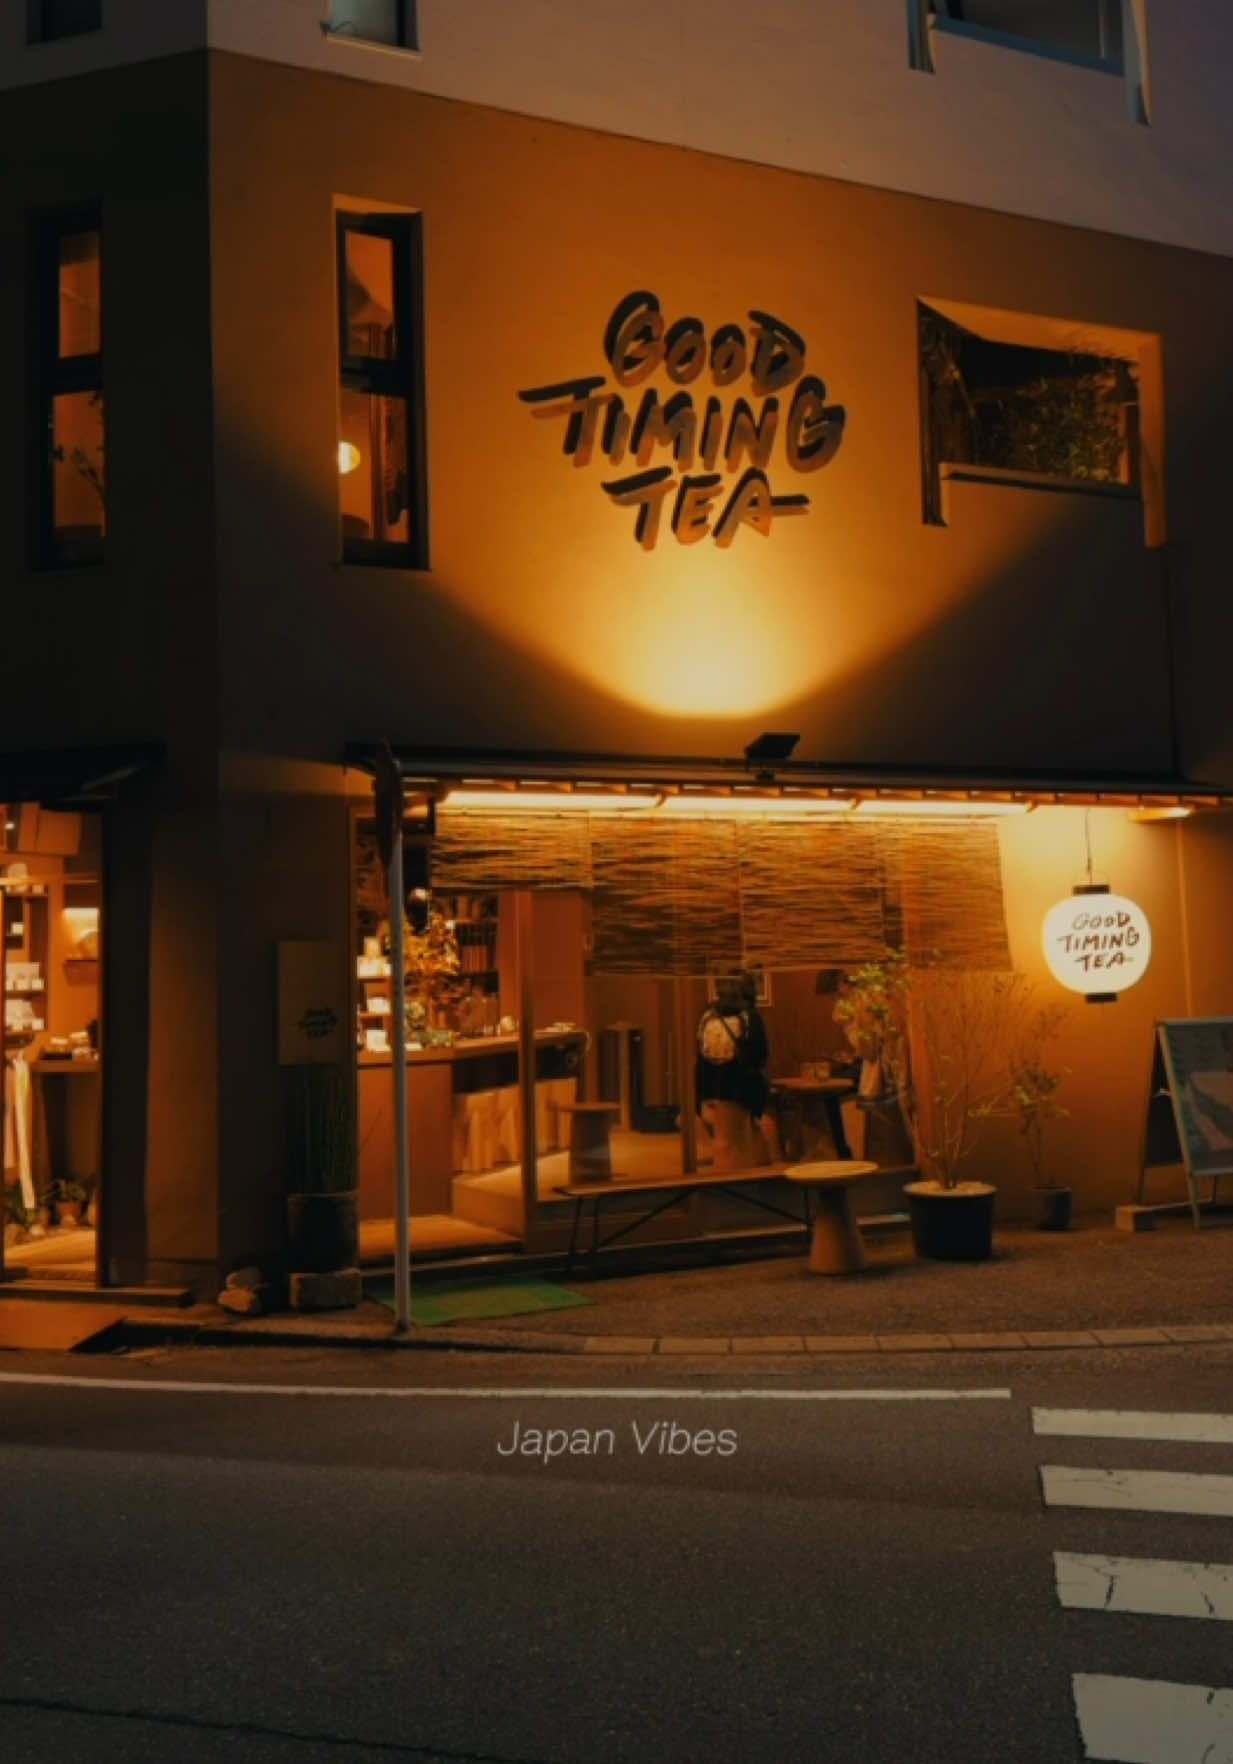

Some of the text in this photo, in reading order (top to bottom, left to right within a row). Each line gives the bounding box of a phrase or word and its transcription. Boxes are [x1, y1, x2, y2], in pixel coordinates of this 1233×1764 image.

[604, 291, 806, 395] GOOD
[518, 376, 846, 473] TIMING
[601, 466, 810, 551] TEA
[1056, 926, 1140, 953] TIMING
[1072, 911, 1131, 930] GOOD
[1074, 952, 1134, 972] TEA
